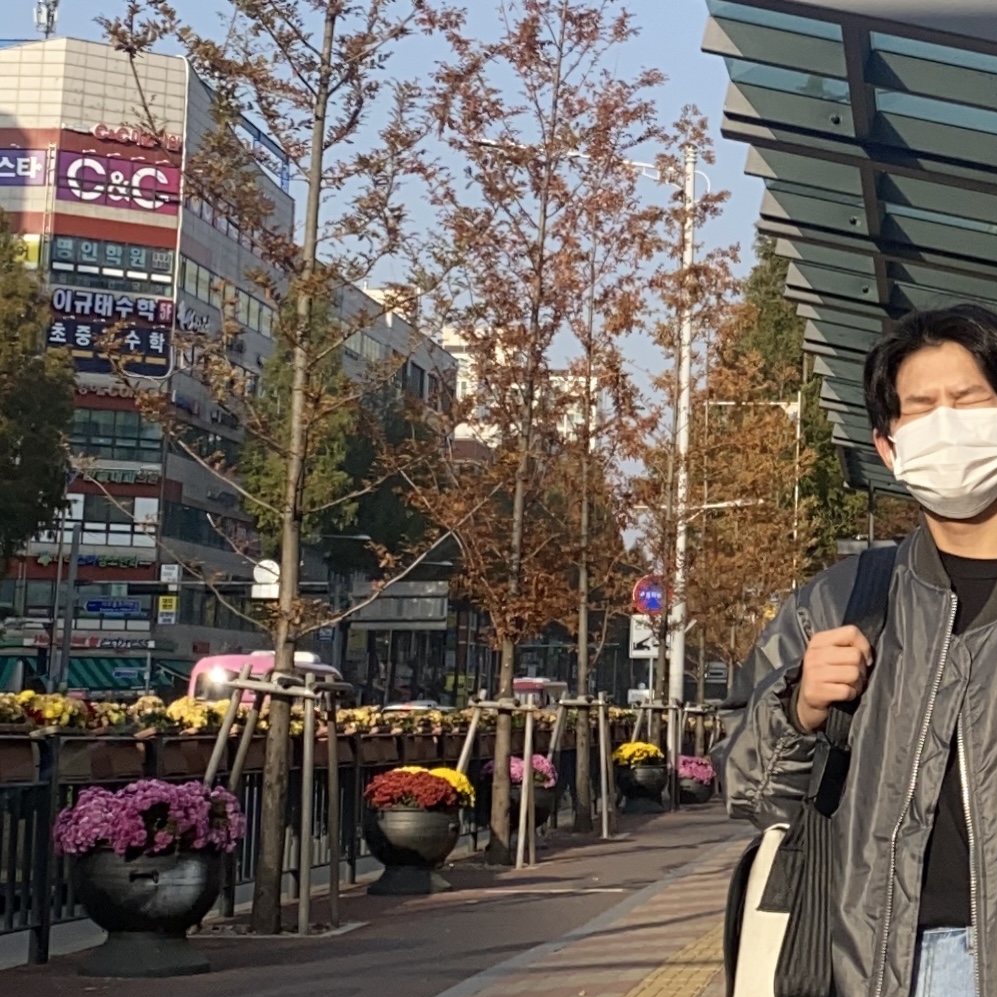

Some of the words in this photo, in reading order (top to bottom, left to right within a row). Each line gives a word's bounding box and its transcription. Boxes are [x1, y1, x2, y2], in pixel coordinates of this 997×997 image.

[67, 158, 169, 209] C&C
[53, 288, 156, 321] 이규태수학
[159, 303, 172, 321] 5F
